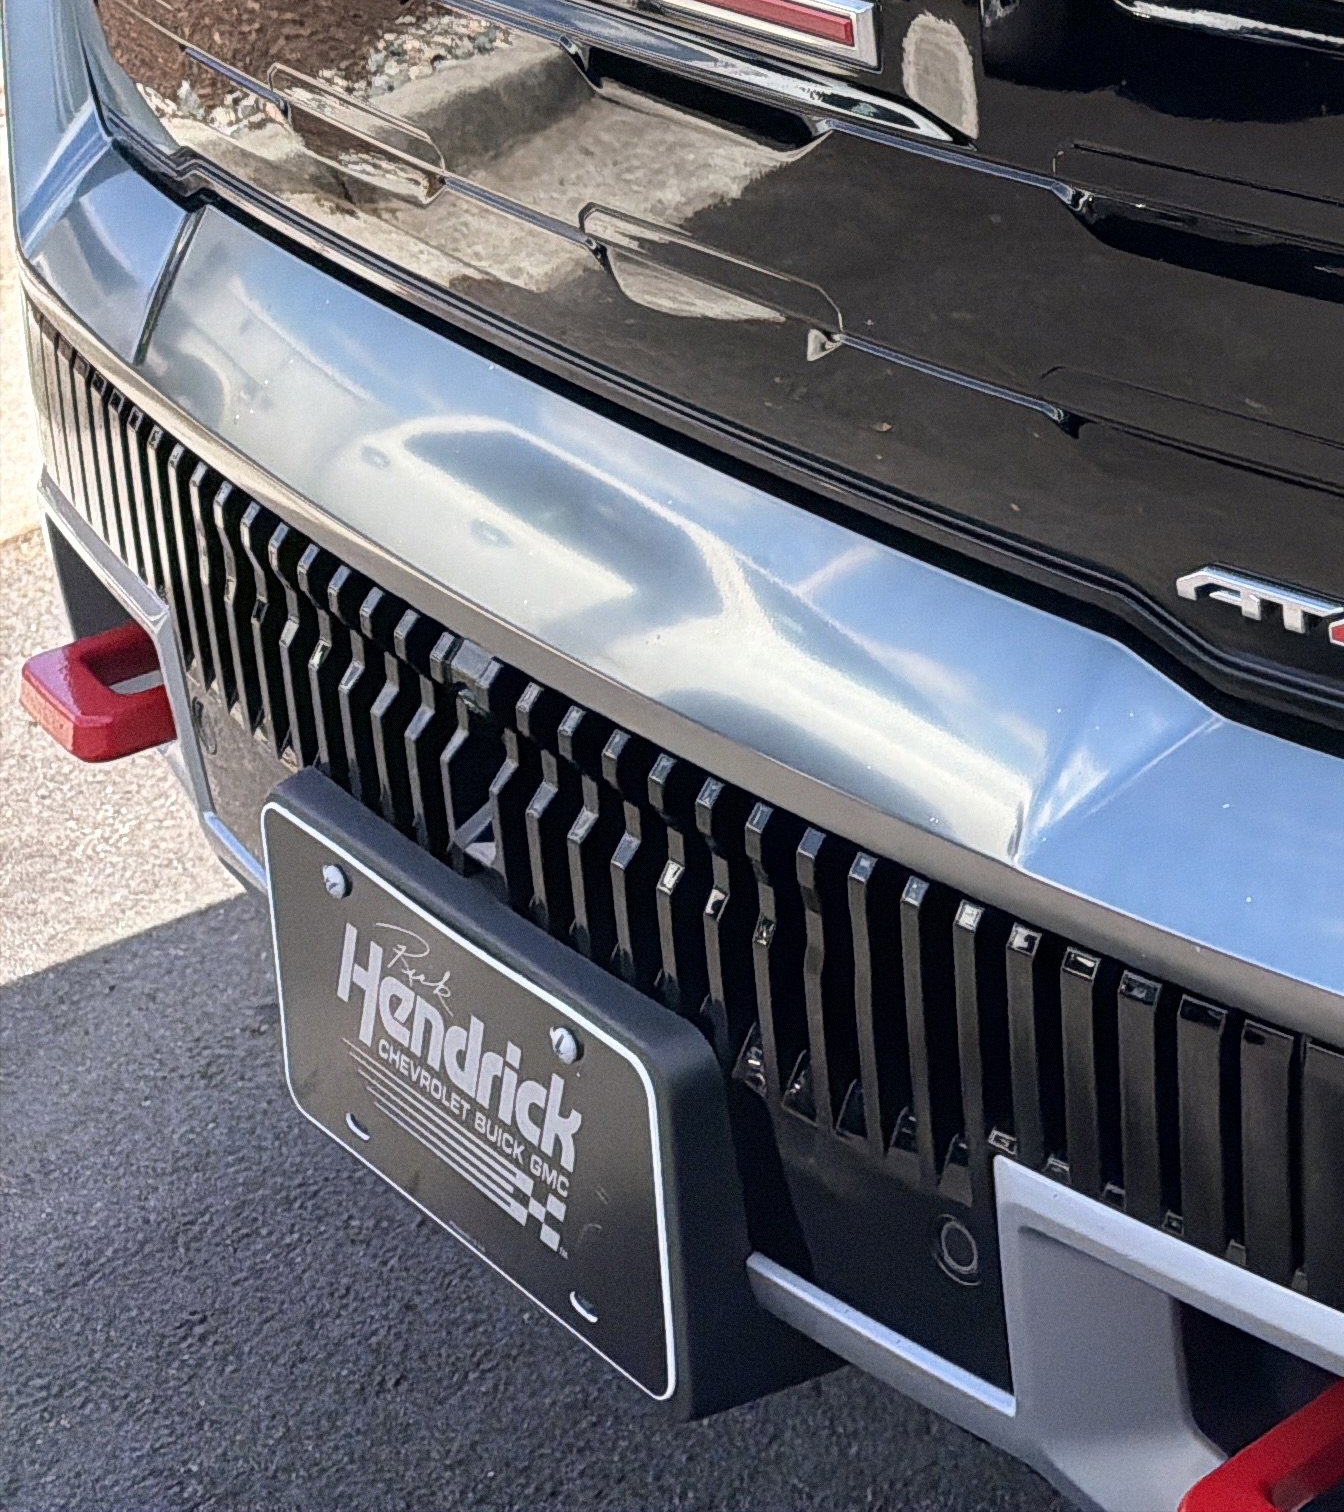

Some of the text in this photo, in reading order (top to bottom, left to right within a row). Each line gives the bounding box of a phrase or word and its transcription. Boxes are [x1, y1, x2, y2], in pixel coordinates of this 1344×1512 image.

[336, 921, 582, 1173] Hendrick
[378, 1038, 570, 1198] CHEVROLET BUICK GMC
